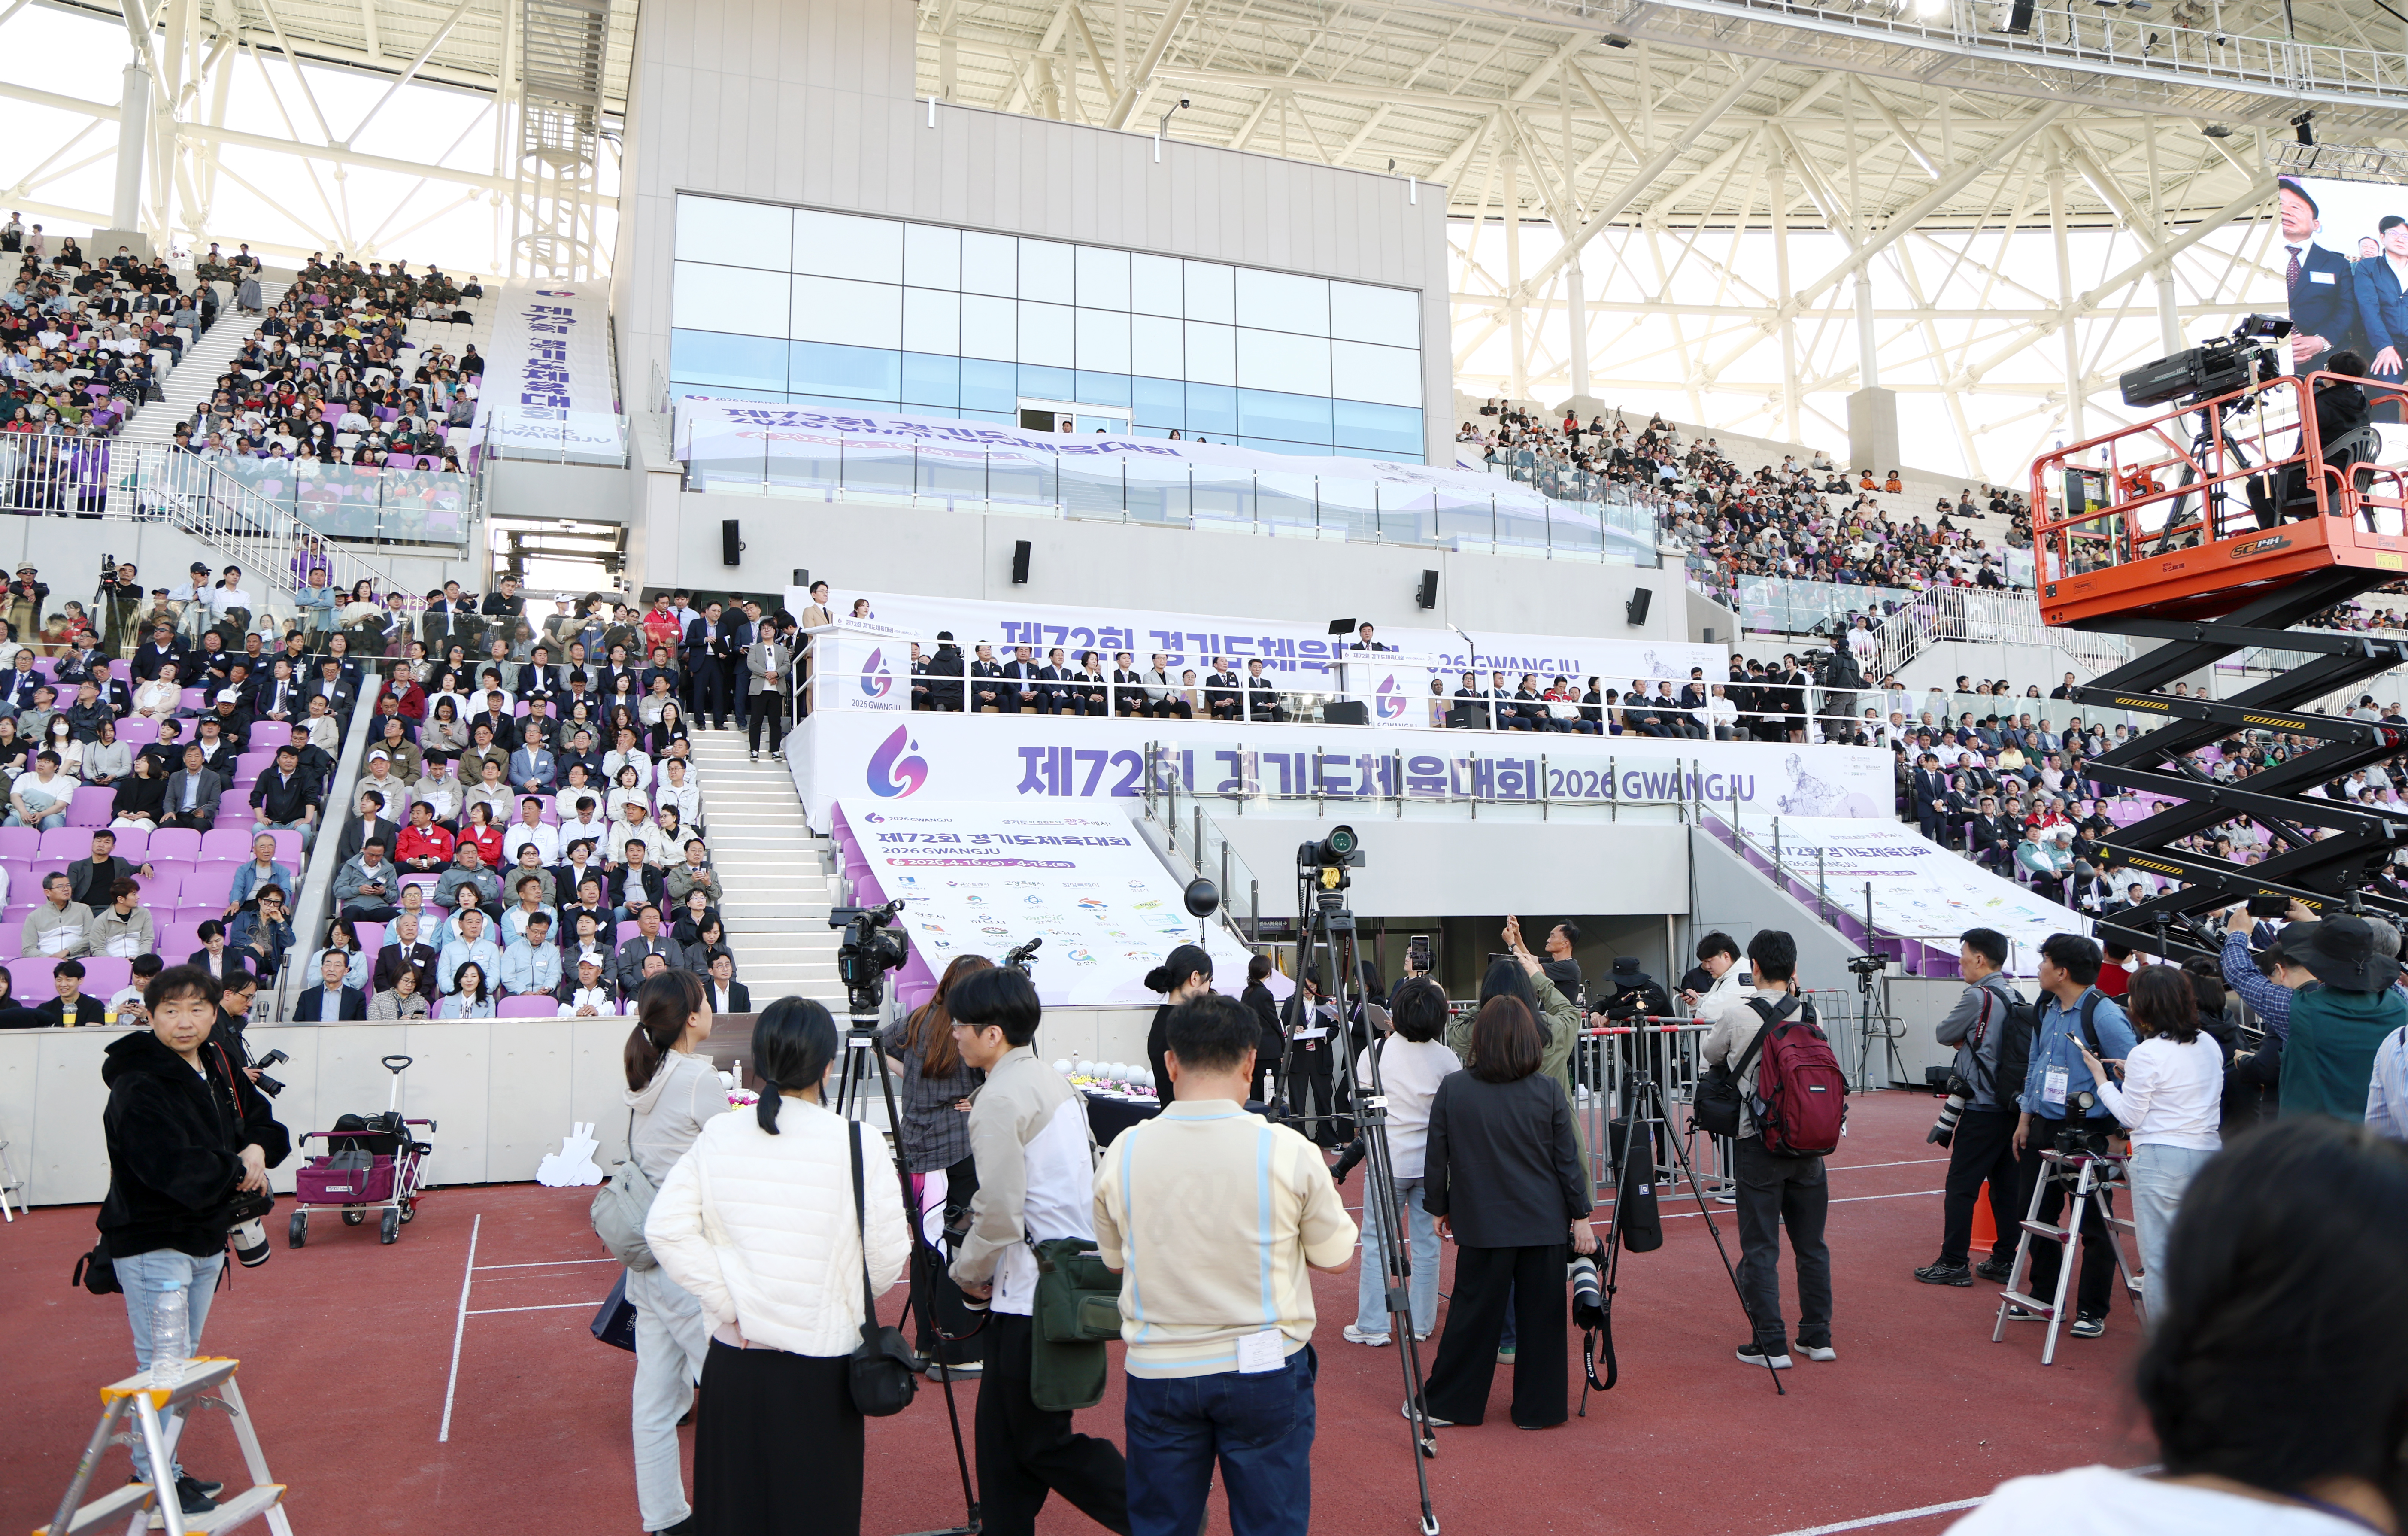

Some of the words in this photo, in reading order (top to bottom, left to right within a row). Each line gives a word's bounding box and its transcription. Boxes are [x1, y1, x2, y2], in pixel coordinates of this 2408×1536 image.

[521, 304, 578, 334] 제72회
[722, 408, 877, 428] 제72회
[479, 424, 611, 443] GWANGJU
[514, 424, 574, 435] 2026
[2233, 544, 2254, 556] SC
[403, 598, 424, 607] W23
[846, 619, 861, 628] 제72회
[863, 622, 893, 633] 경기도체육대회
[852, 699, 867, 708] 2026
[1016, 746, 1194, 798] 제72회
[1215, 750, 1536, 801] 경기도체육대회
[1549, 769, 1617, 798] 2026
[1622, 771, 1754, 801] GWANGJU
[876, 832, 961, 843] 제72회
[967, 834, 1131, 846] 경기도체육대회
